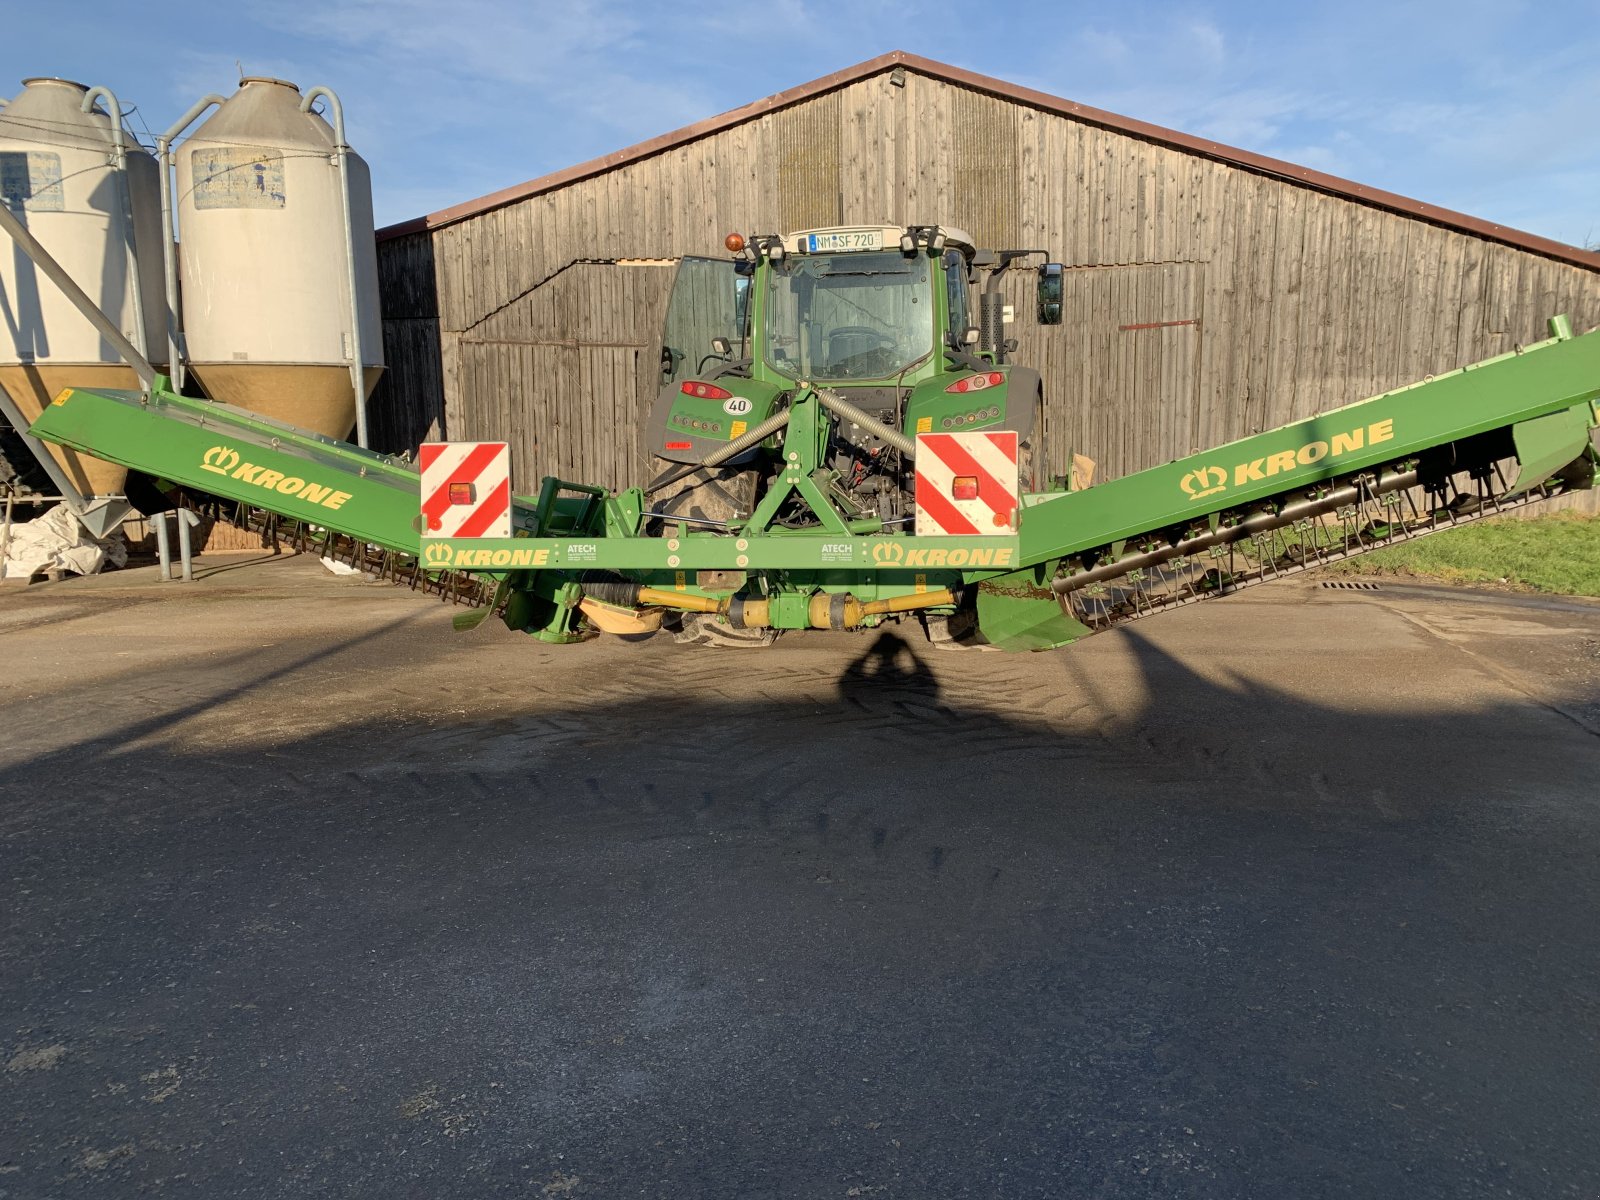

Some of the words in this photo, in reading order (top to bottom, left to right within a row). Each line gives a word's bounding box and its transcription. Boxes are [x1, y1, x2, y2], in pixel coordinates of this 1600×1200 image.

[817, 236, 831, 248] NM
[838, 235, 851, 247] SF
[854, 234, 874, 247] 720
[729, 401, 746, 412] 40
[1234, 417, 1394, 486] KRONE
[231, 462, 353, 510] KRONE
[567, 544, 596, 553] ATECH
[821, 544, 852, 553] ATECH
[454, 549, 550, 566] KRONE
[904, 548, 1013, 566] KRONE
